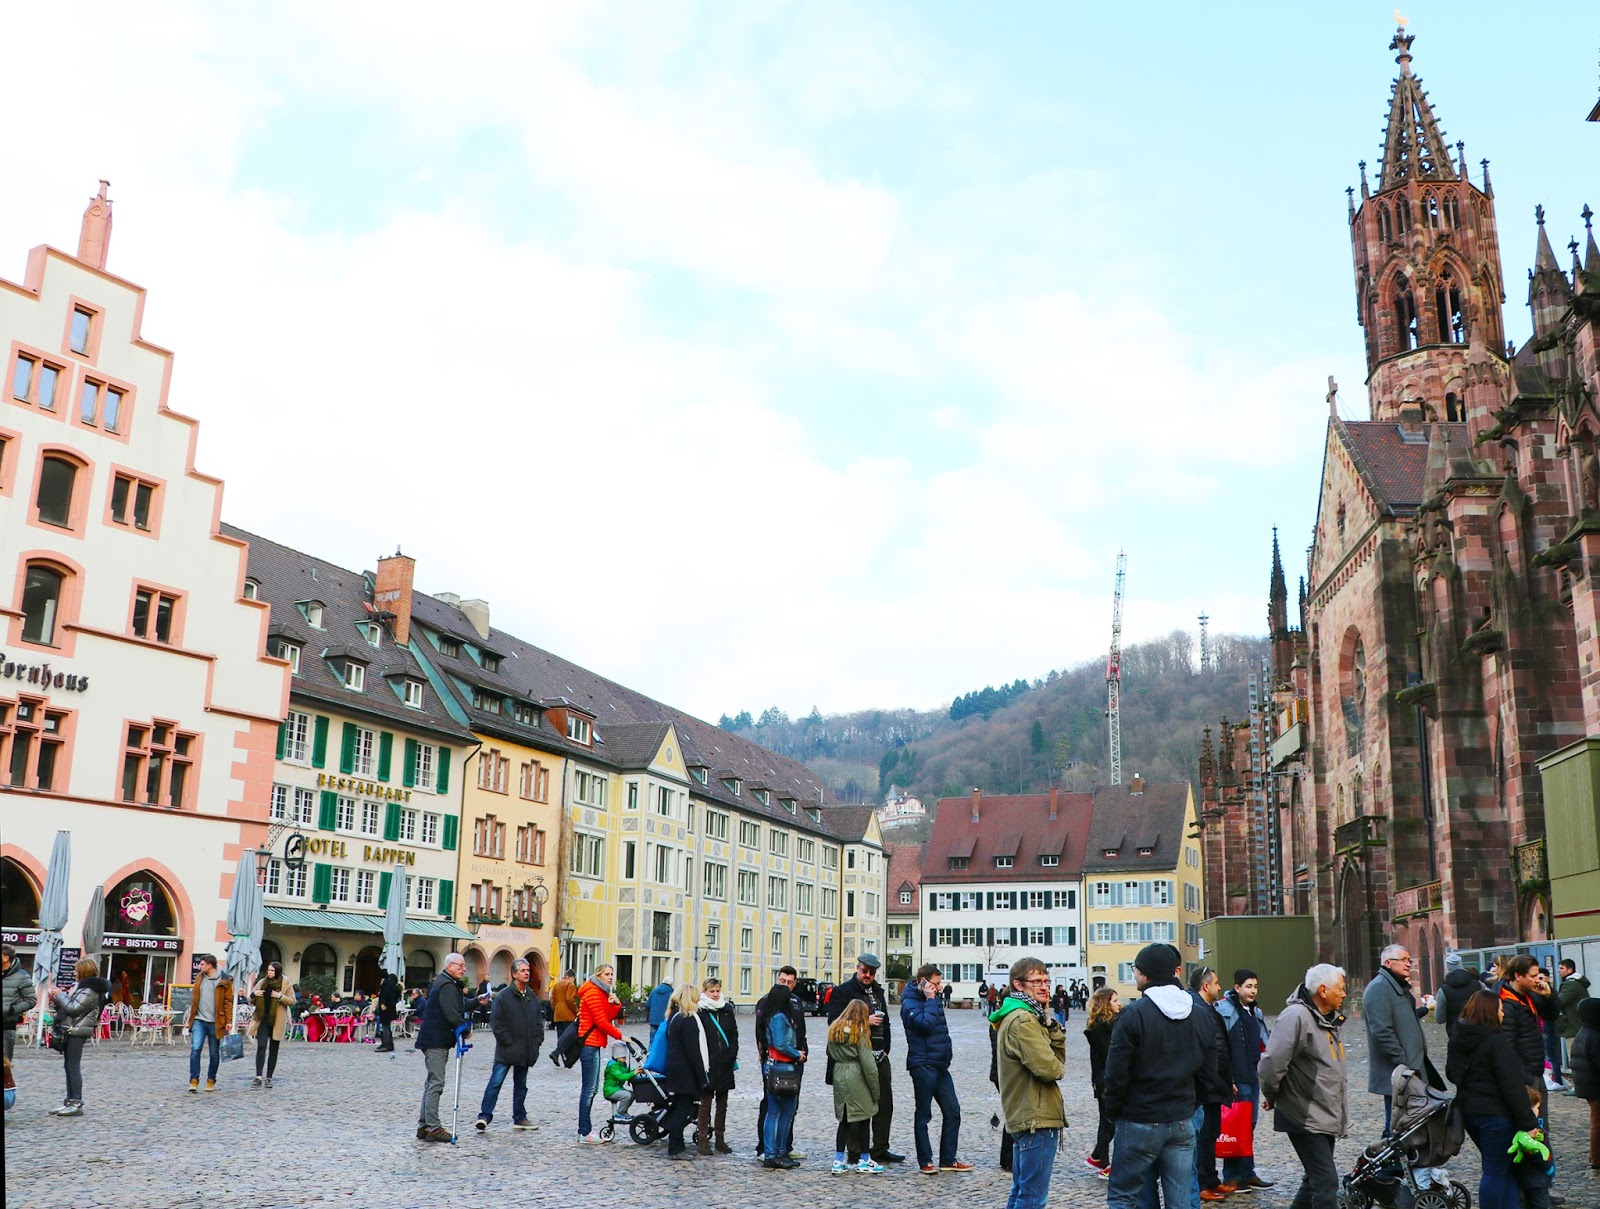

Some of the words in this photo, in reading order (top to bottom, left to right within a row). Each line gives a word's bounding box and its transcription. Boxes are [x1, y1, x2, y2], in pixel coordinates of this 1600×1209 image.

[317, 773, 412, 802] RESTAURANT
[298, 836, 348, 858] HOTEL
[363, 845, 416, 866] RAPPEN
[102, 937, 120, 946] AFE
[126, 938, 158, 948] BISTRO
[164, 941, 178, 949] EIS
